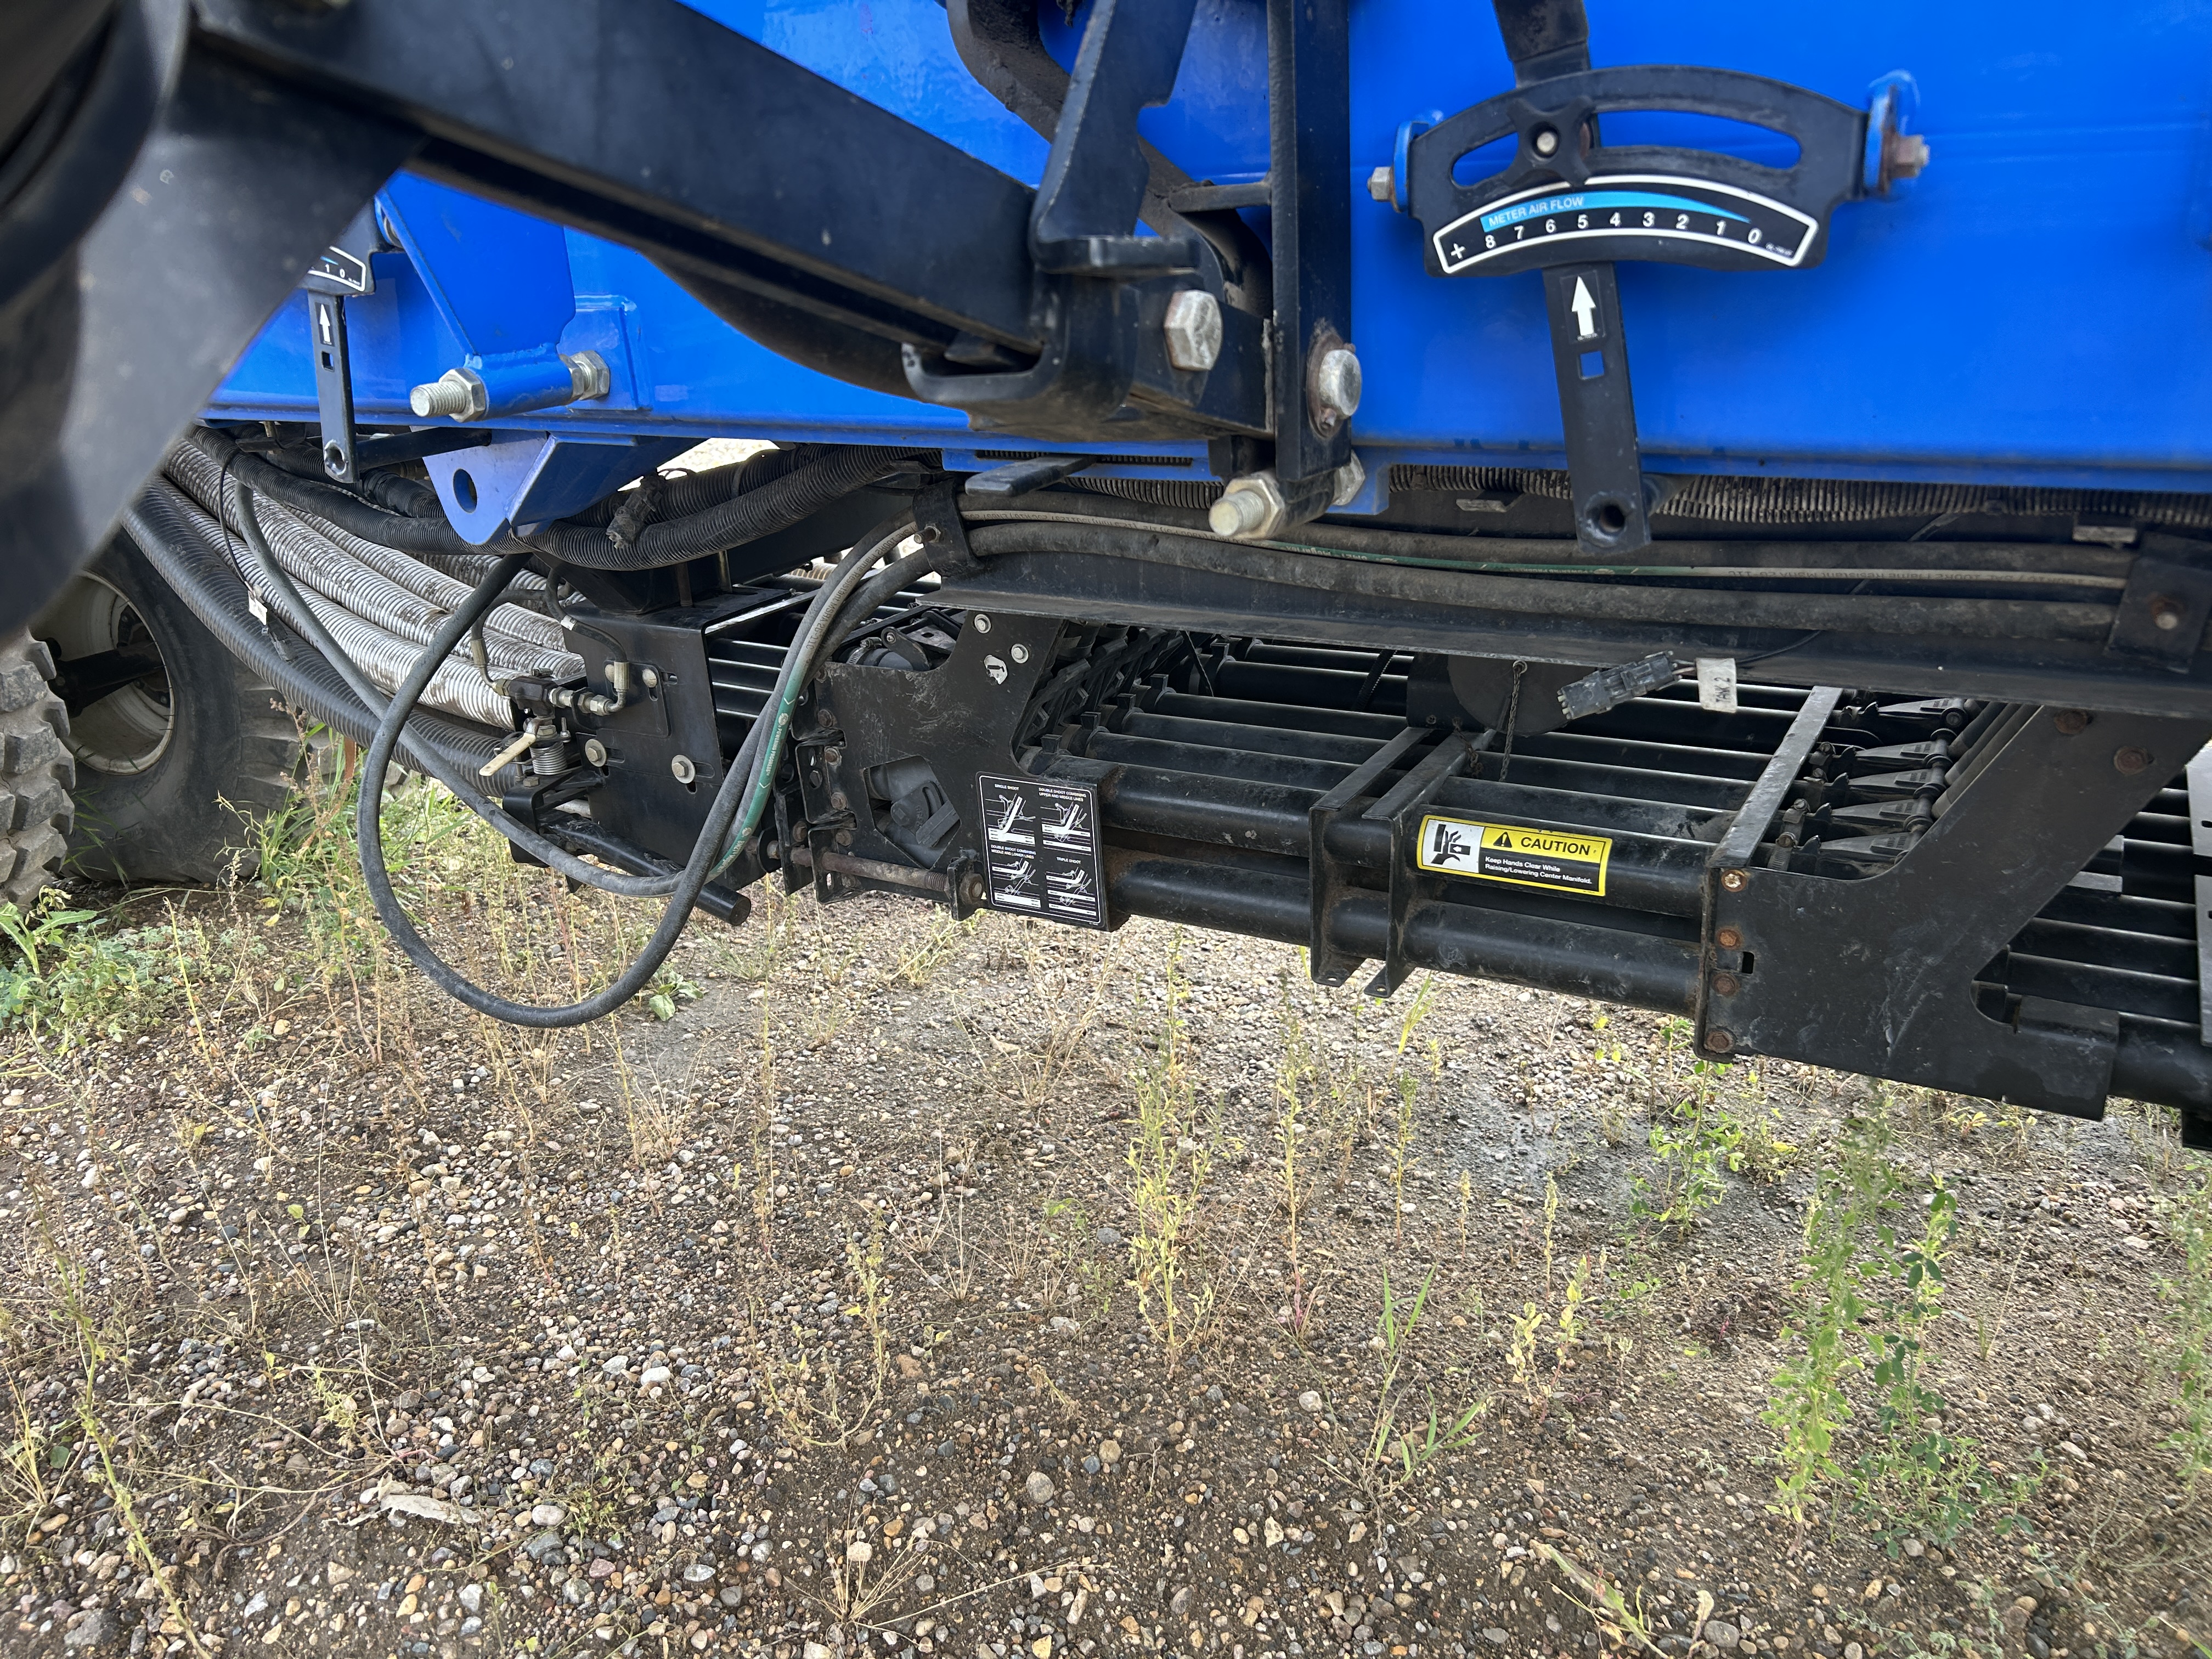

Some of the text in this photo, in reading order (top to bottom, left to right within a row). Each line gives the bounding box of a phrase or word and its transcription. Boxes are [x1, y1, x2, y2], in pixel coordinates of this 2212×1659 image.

[1488, 196, 1584, 227] METER AIR FLOW
[1485, 234, 1497, 249] 8
[1514, 225, 1525, 240] 7
[1545, 219, 1557, 233] 6
[1577, 214, 1589, 229] 5
[1609, 212, 1621, 227] 4
[1643, 211, 1655, 228] 3
[1675, 213, 1690, 230] 2
[1716, 220, 1726, 236] 1
[1747, 228, 1763, 244] 0
[325, 264, 346, 278] 1 0
[895, 529, 911, 538] SAE
[834, 571, 860, 603] Resistant
[1520, 837, 1591, 855] CAUTION
[1485, 856, 1561, 872] Keep Hands Clear While
[1485, 864, 1593, 884] Raising/Lowering Center Manifold.
